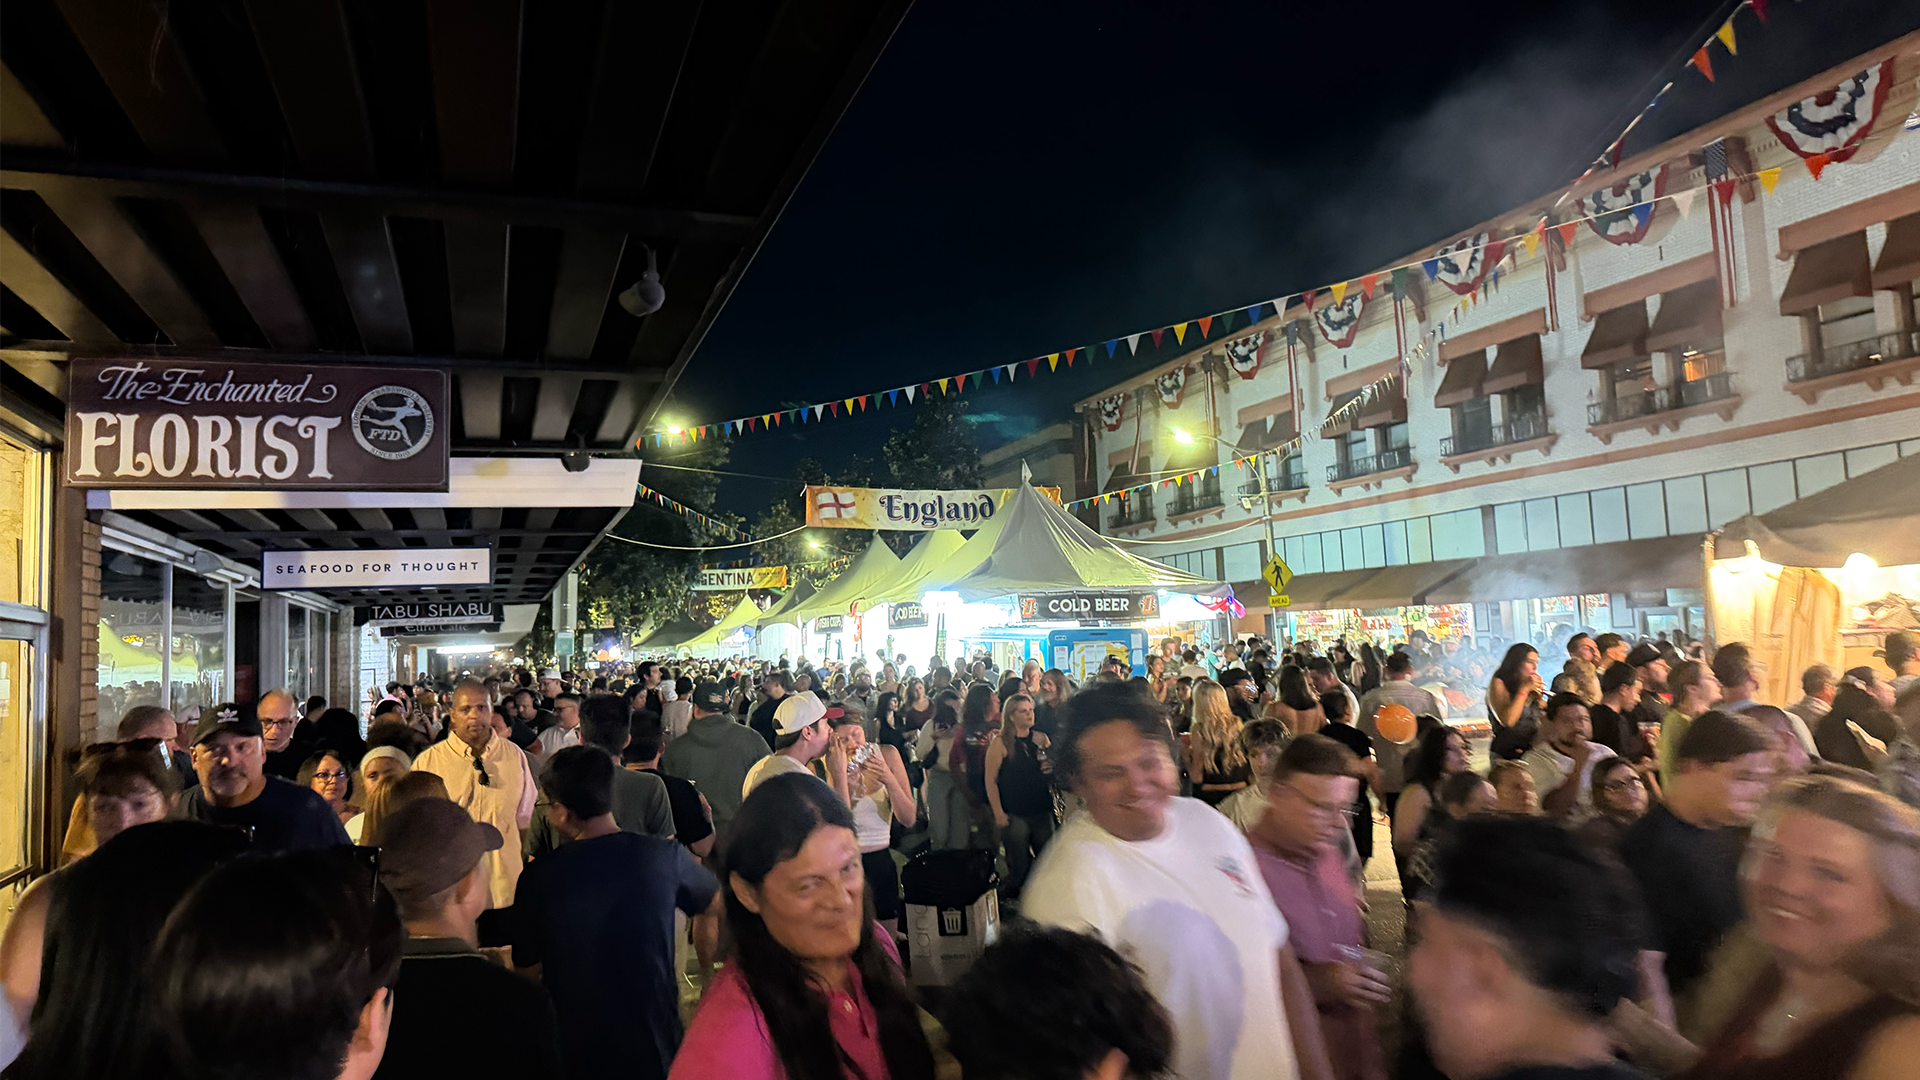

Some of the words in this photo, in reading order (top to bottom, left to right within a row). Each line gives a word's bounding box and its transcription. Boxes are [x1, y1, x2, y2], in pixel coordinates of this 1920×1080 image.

[98, 362, 161, 400] The
[157, 369, 338, 405] Enchanted
[368, 429, 402, 441] FTD
[75, 411, 342, 480] FLORIST
[879, 494, 995, 528] England
[276, 564, 354, 575] SEAFOOD
[362, 563, 392, 573] FOR
[402, 561, 479, 572] THOUGHT
[701, 571, 755, 586] GENTINA
[372, 605, 419, 618] TABU
[428, 602, 491, 616] SHABU
[1048, 599, 1091, 613] COLD
[1095, 597, 1129, 612] BEER
